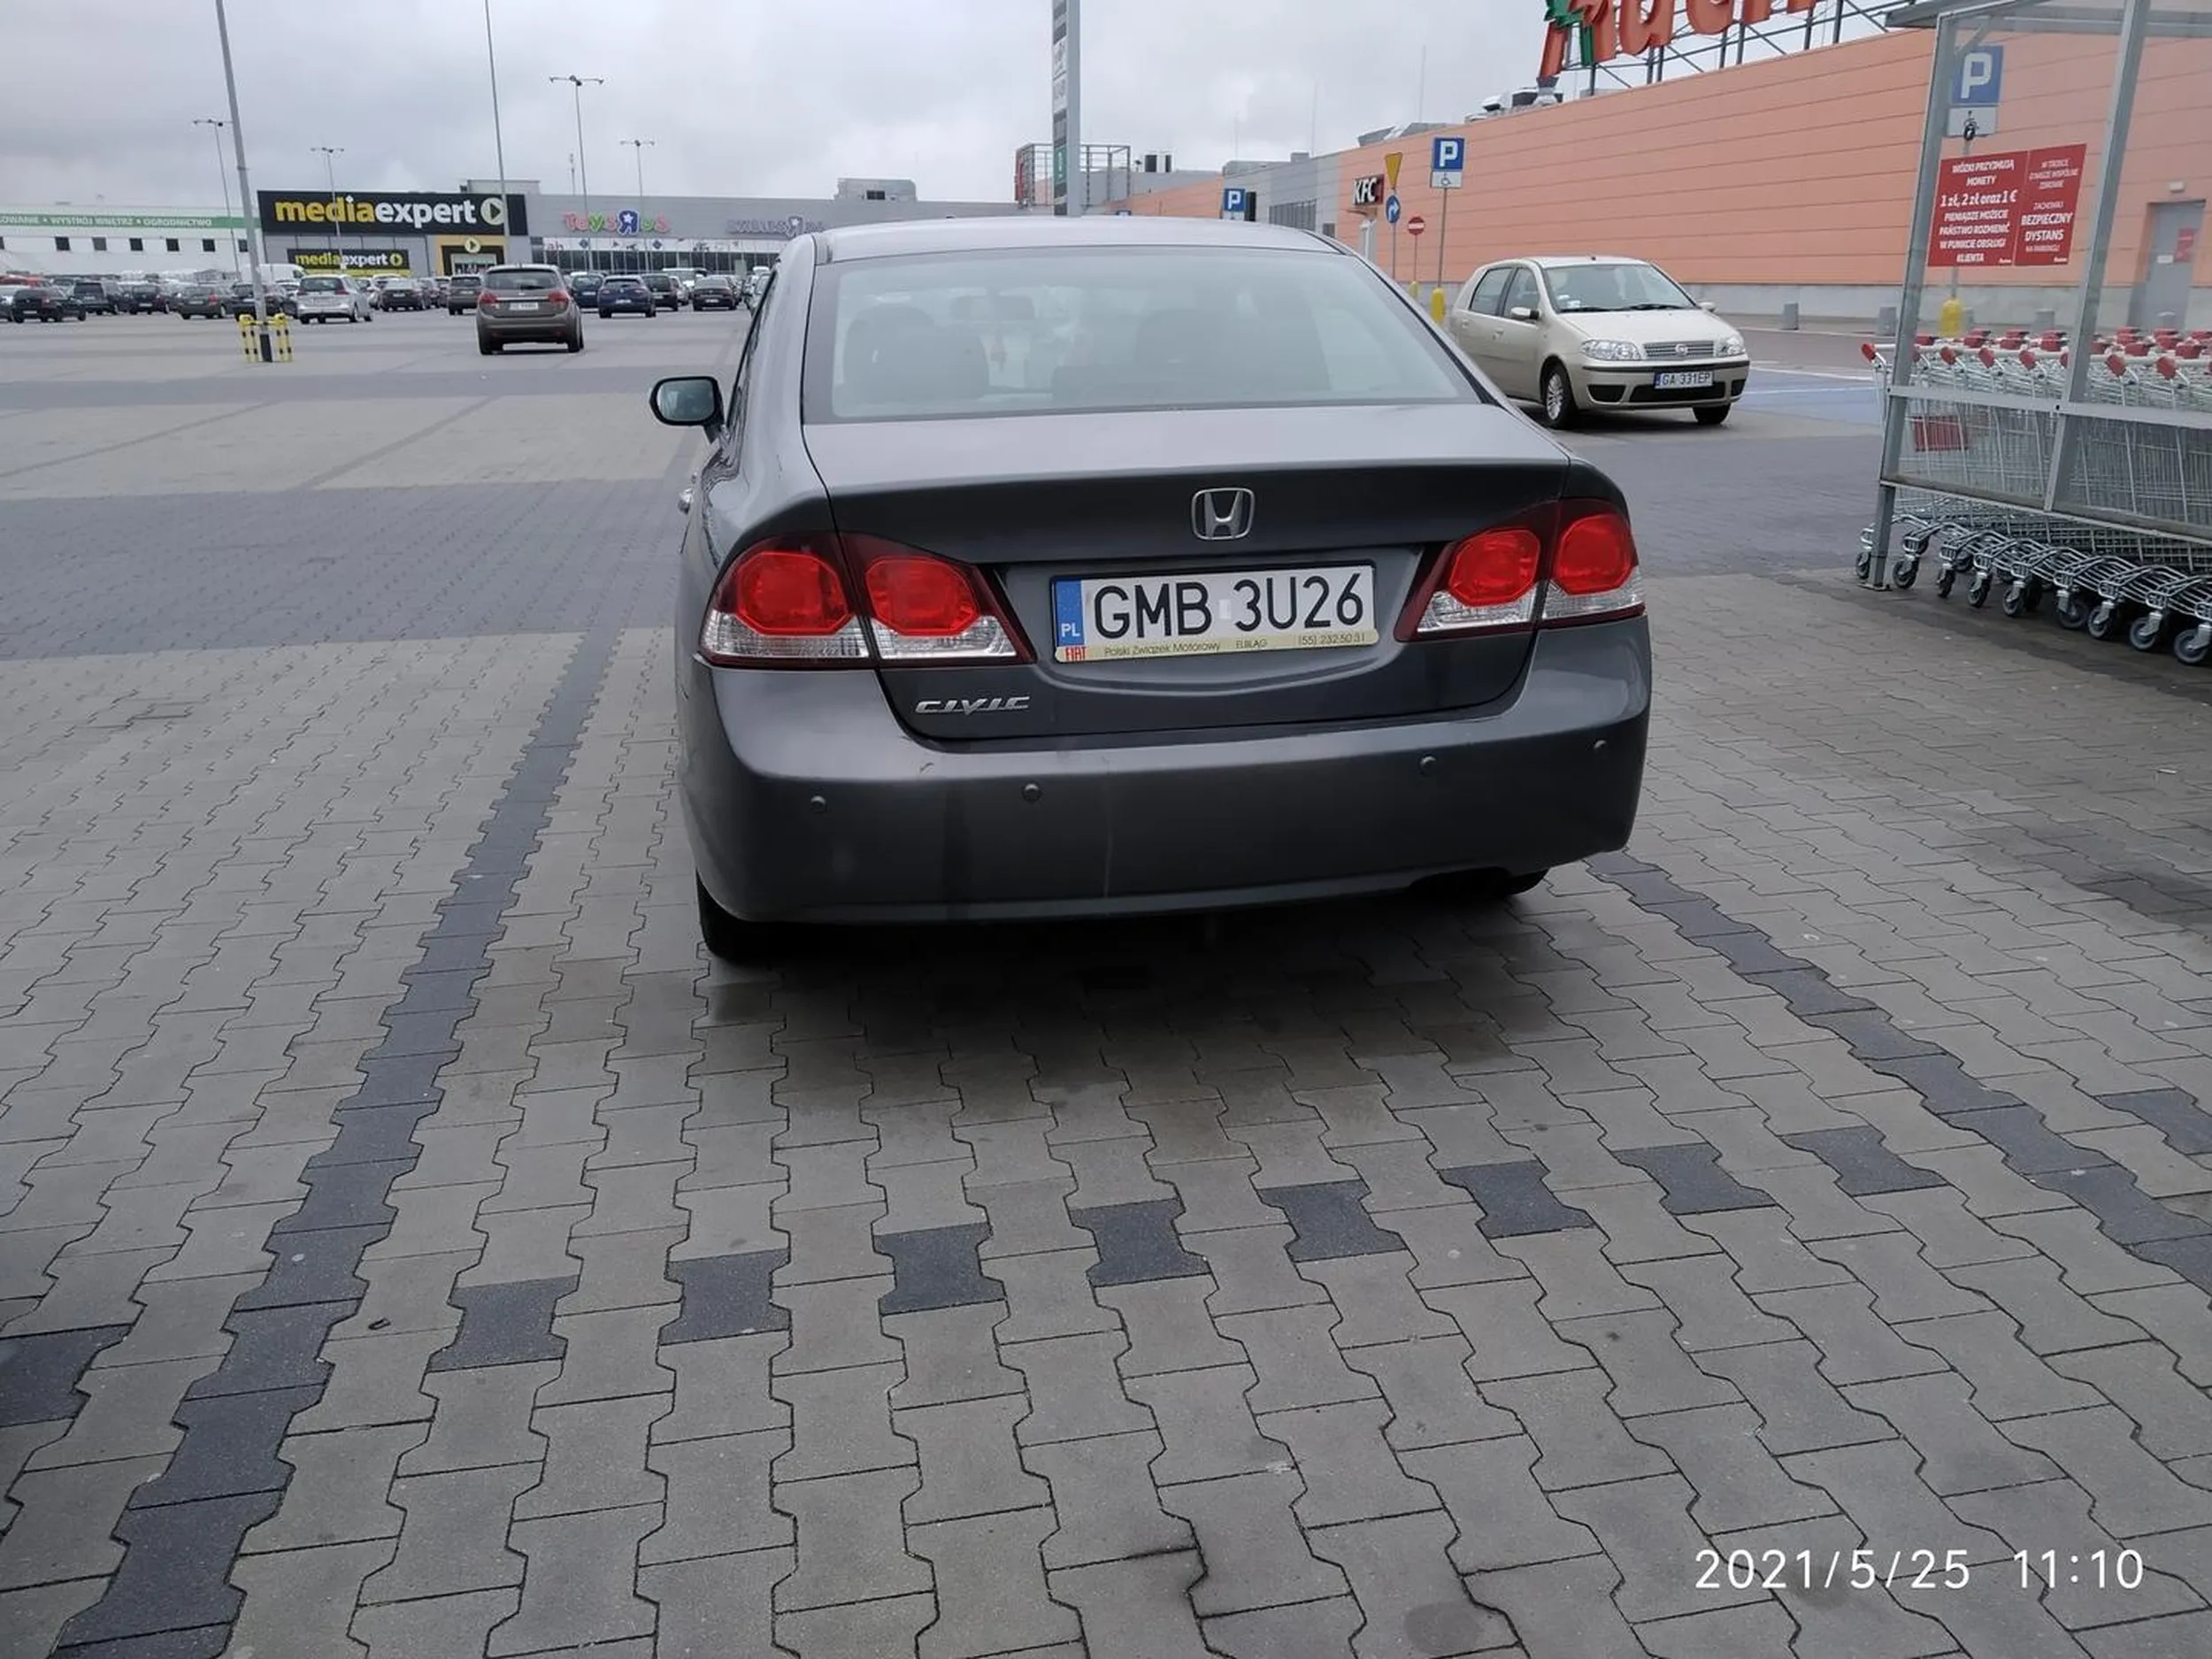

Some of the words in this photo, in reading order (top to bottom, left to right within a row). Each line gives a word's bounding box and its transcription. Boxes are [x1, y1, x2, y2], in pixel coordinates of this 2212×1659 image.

[1961, 53, 1993, 99] P
[1439, 141, 1458, 167] P
[1966, 175, 1996, 187] MONETY
[1352, 177, 1377, 204] KFC
[1939, 195, 1947, 207] 1
[1961, 193, 1969, 205] 2
[1969, 192, 1979, 205] zł
[1980, 194, 2000, 204] oraz
[2001, 190, 2008, 204] 1
[2009, 188, 2018, 202] €
[1227, 190, 1241, 210] P
[2021, 212, 2074, 226] BEZPIECZNY
[2024, 229, 2065, 242] DYSTANS
[1956, 253, 1984, 263] KLIENTA
[1094, 582, 1212, 639] GMB
[1233, 572, 1364, 632] 3U26
[1061, 623, 1080, 638] PL
[1065, 646, 1087, 660] FIAT
[1104, 646, 1130, 657] Polski
[1172, 641, 1220, 654] Motorowy
[916, 696, 1030, 715] CIVIC
